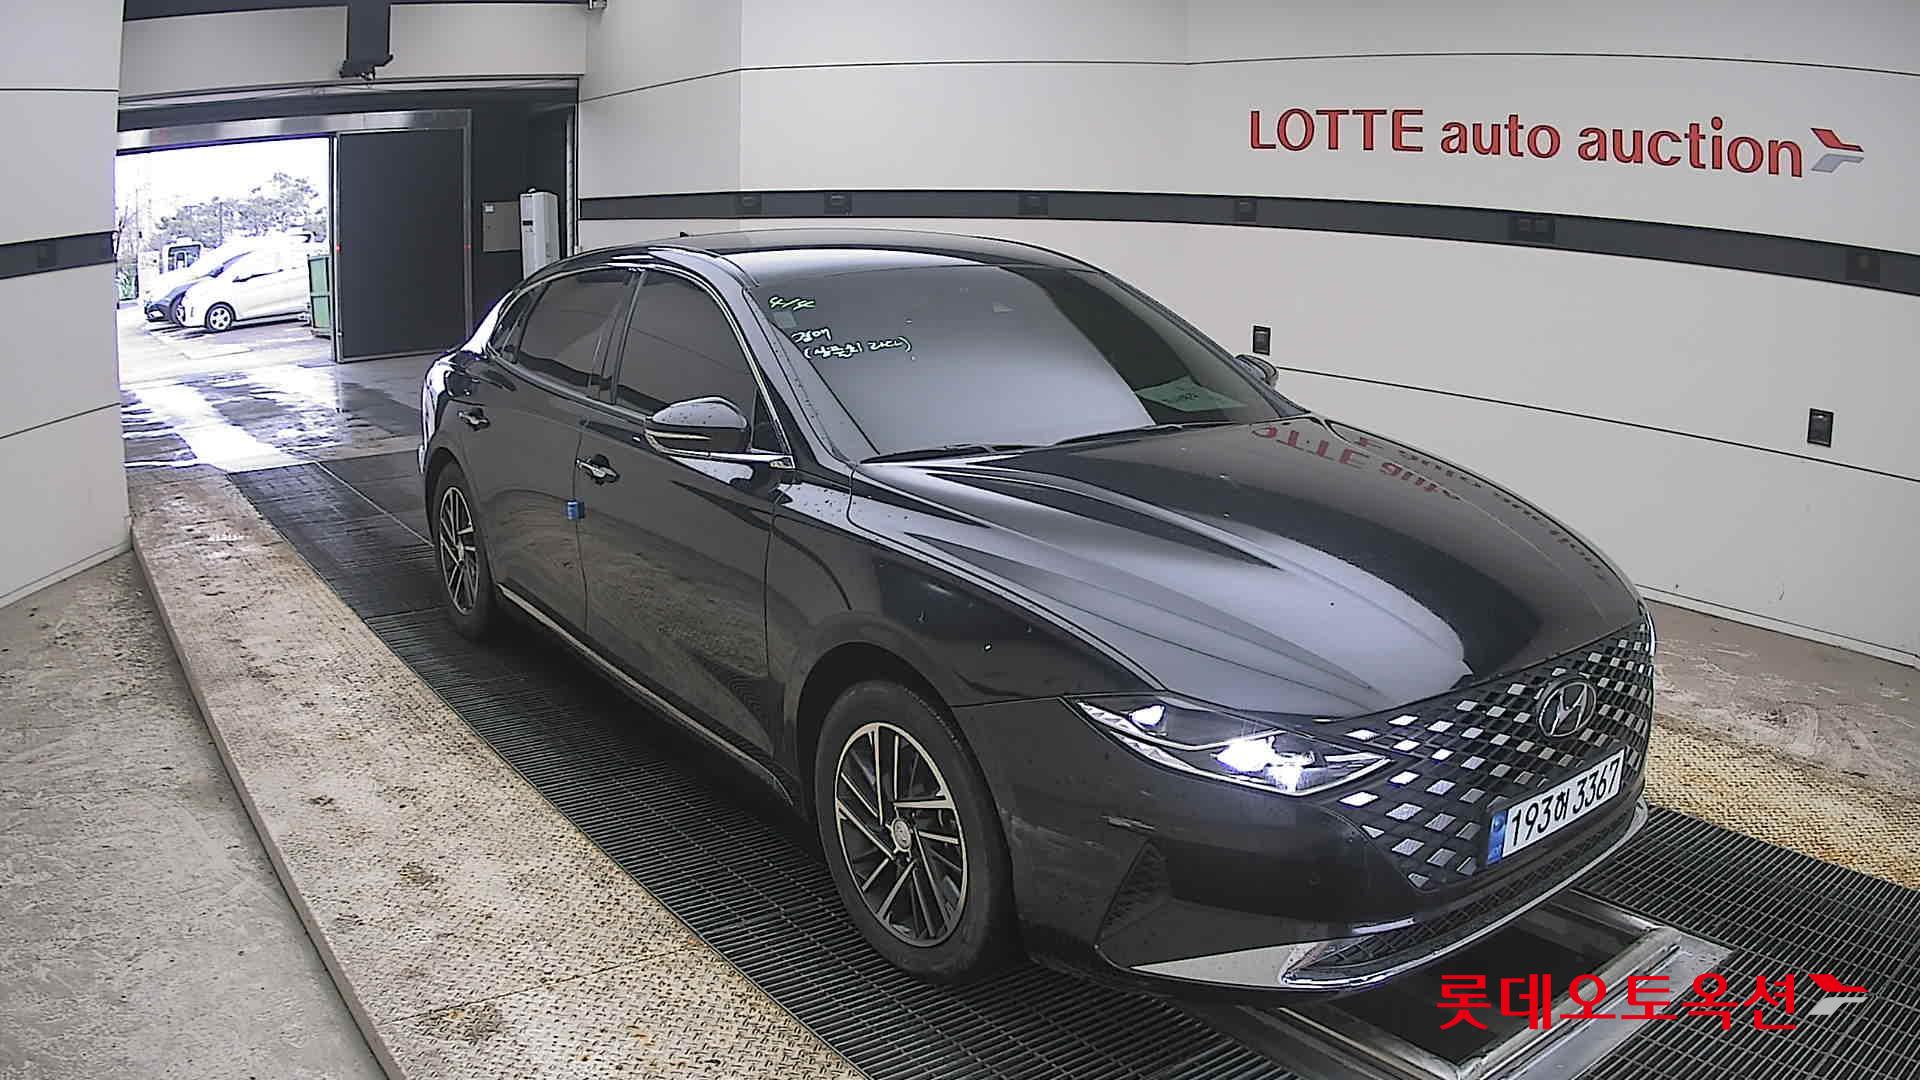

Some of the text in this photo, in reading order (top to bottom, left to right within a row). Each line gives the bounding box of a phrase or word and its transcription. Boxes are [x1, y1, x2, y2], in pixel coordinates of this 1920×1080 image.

[1249, 109, 1803, 178] LOTTE auto auction
[1512, 758, 1620, 847] 193허 3367
